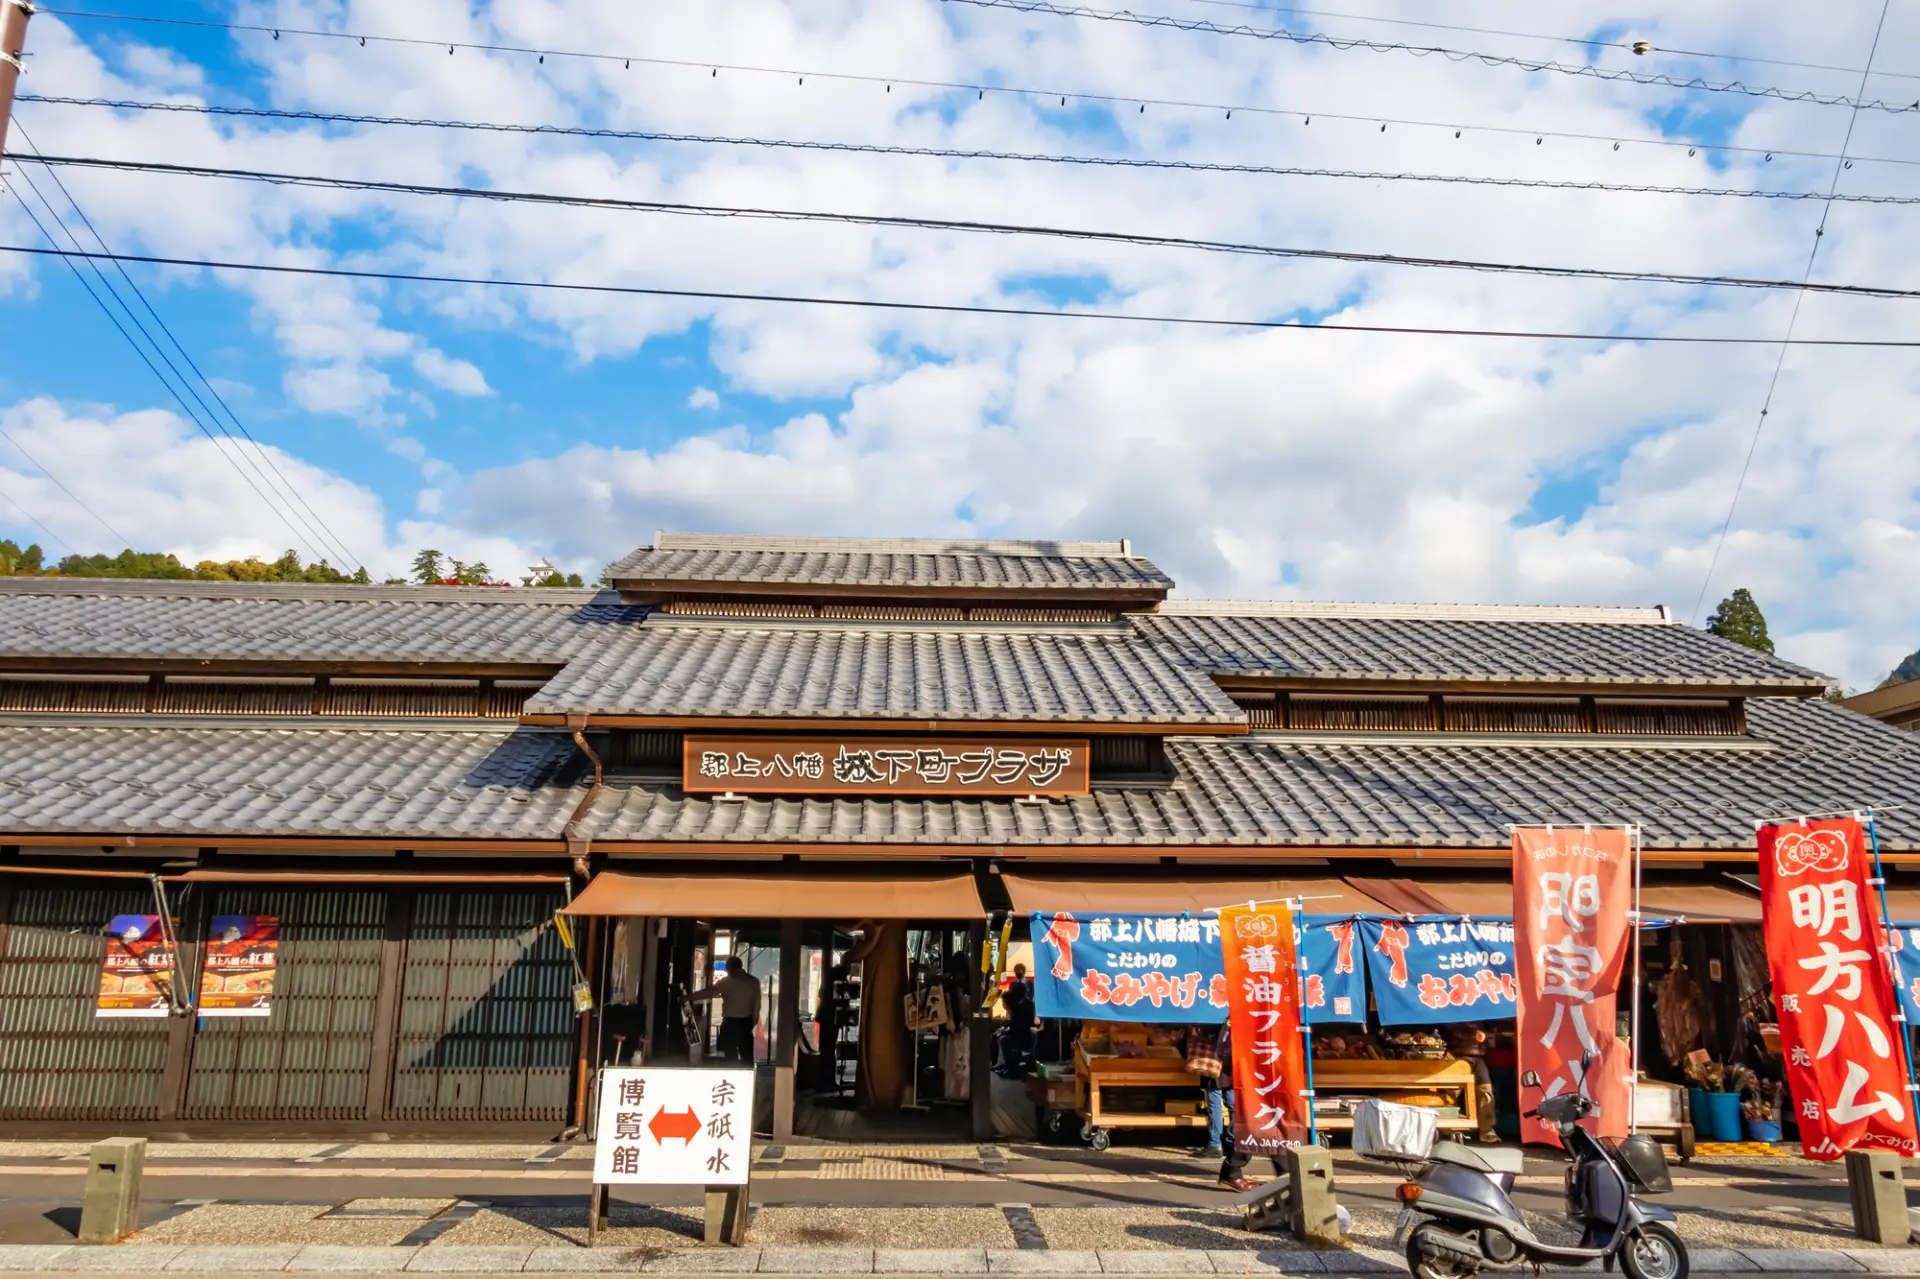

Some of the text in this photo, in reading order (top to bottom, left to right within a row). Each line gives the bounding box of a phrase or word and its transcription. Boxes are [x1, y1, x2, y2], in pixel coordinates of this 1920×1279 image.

[699, 745, 1072, 787] 郡上八幡 城下町プラザ
[1106, 952, 1177, 969] こだわりの
[1437, 951, 1507, 969] こだわりの
[1788, 878, 1905, 1125] 明方ハム
[1240, 944, 1286, 1131] 醤油フランク
[1781, 993, 1819, 1121] 販売店
[612, 1078, 646, 1175] 博覧館
